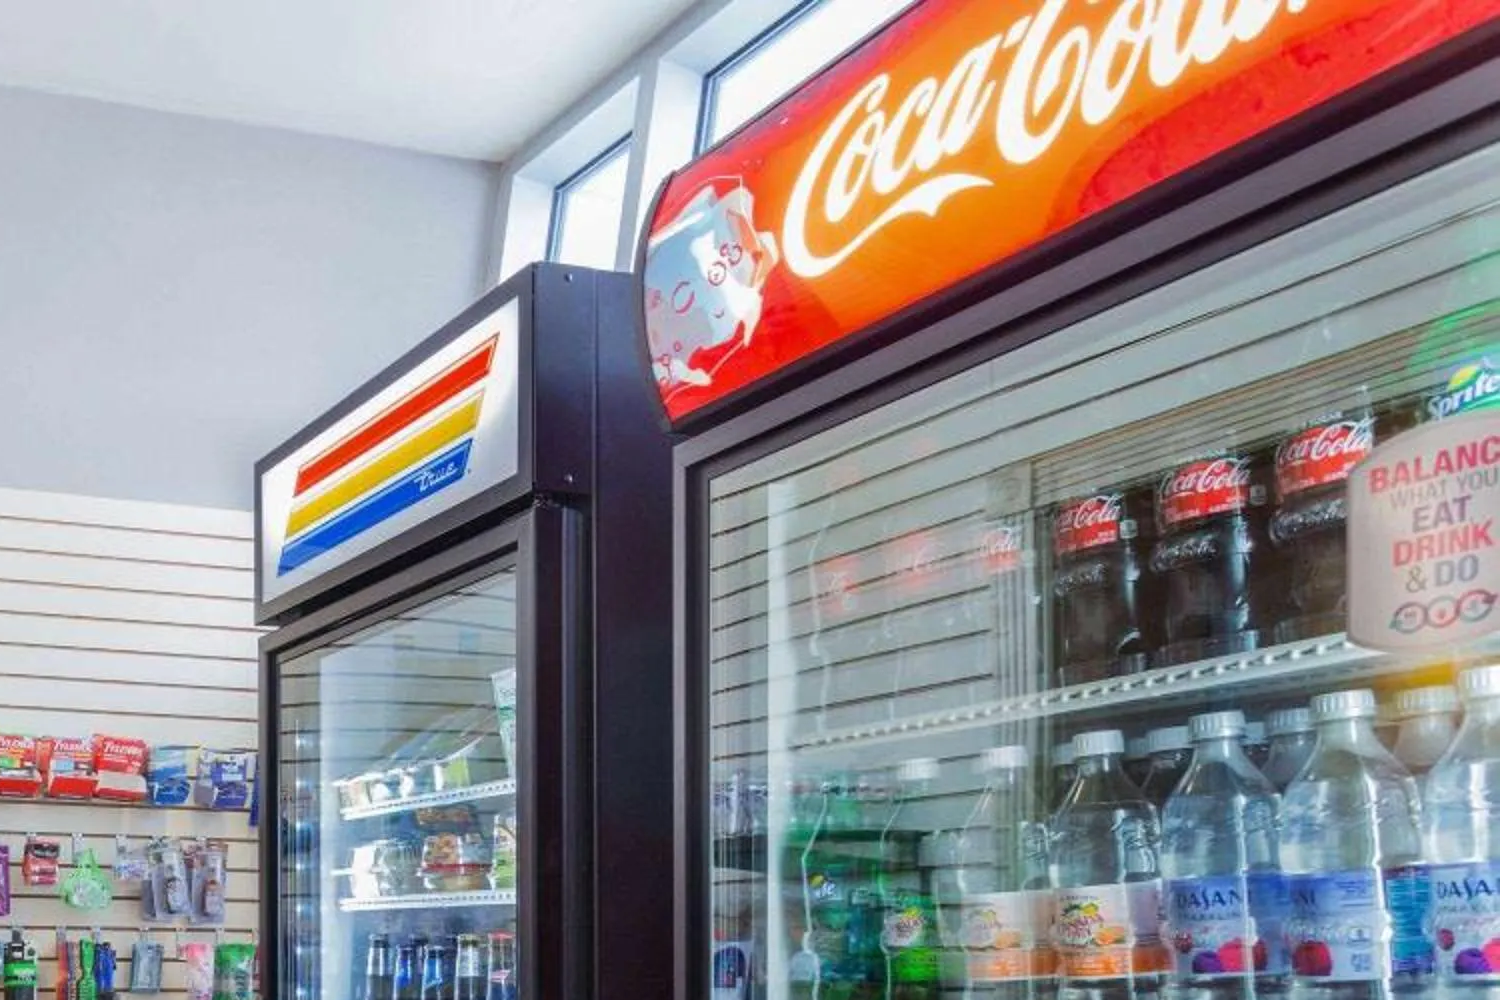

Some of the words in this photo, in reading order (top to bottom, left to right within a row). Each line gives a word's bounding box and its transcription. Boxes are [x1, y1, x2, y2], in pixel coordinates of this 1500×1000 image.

[413, 461, 459, 492] True
[1389, 477, 1448, 510] WHAT
[1456, 466, 1500, 491] YOU
[1392, 519, 1495, 568] DRINK
[1406, 566, 1427, 593] &
[1435, 554, 1479, 588] DO
